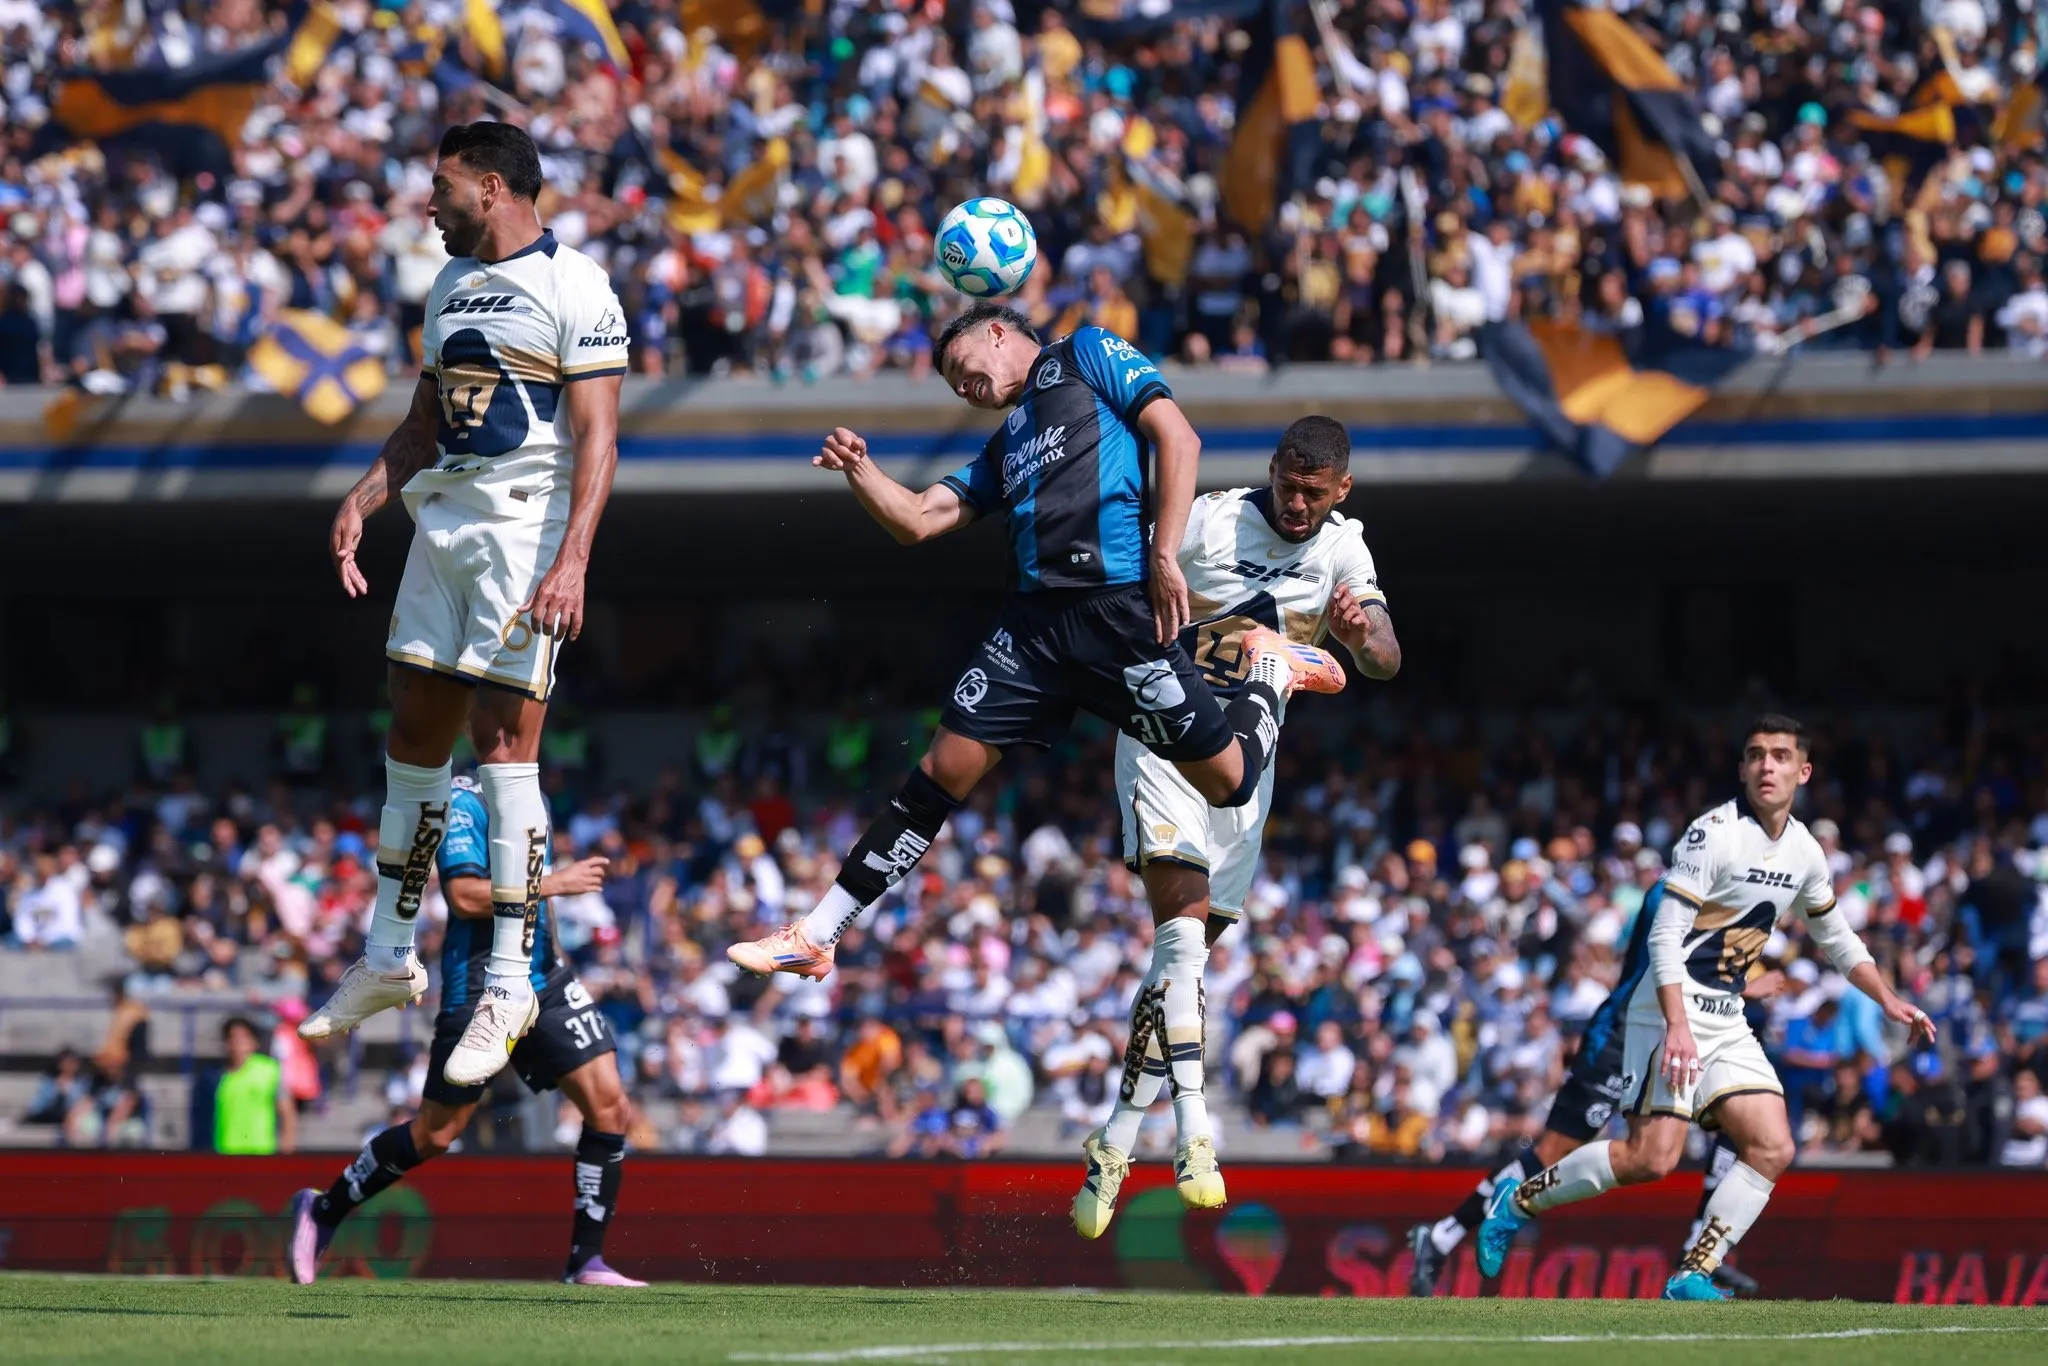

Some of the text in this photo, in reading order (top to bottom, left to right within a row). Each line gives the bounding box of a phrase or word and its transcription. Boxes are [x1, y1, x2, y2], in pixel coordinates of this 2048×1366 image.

[943, 252, 967, 266] Voit
[440, 296, 516, 316] DHL
[578, 336, 627, 347] RALOY
[501, 609, 532, 652] 6
[995, 651, 1020, 670] Angeles
[1130, 713, 1174, 745] 31
[396, 800, 449, 919] CREST
[1678, 861, 1701, 875] GNP
[1745, 868, 1794, 889] DHL
[521, 826, 549, 957] CREST
[564, 1010, 604, 1049] 37
